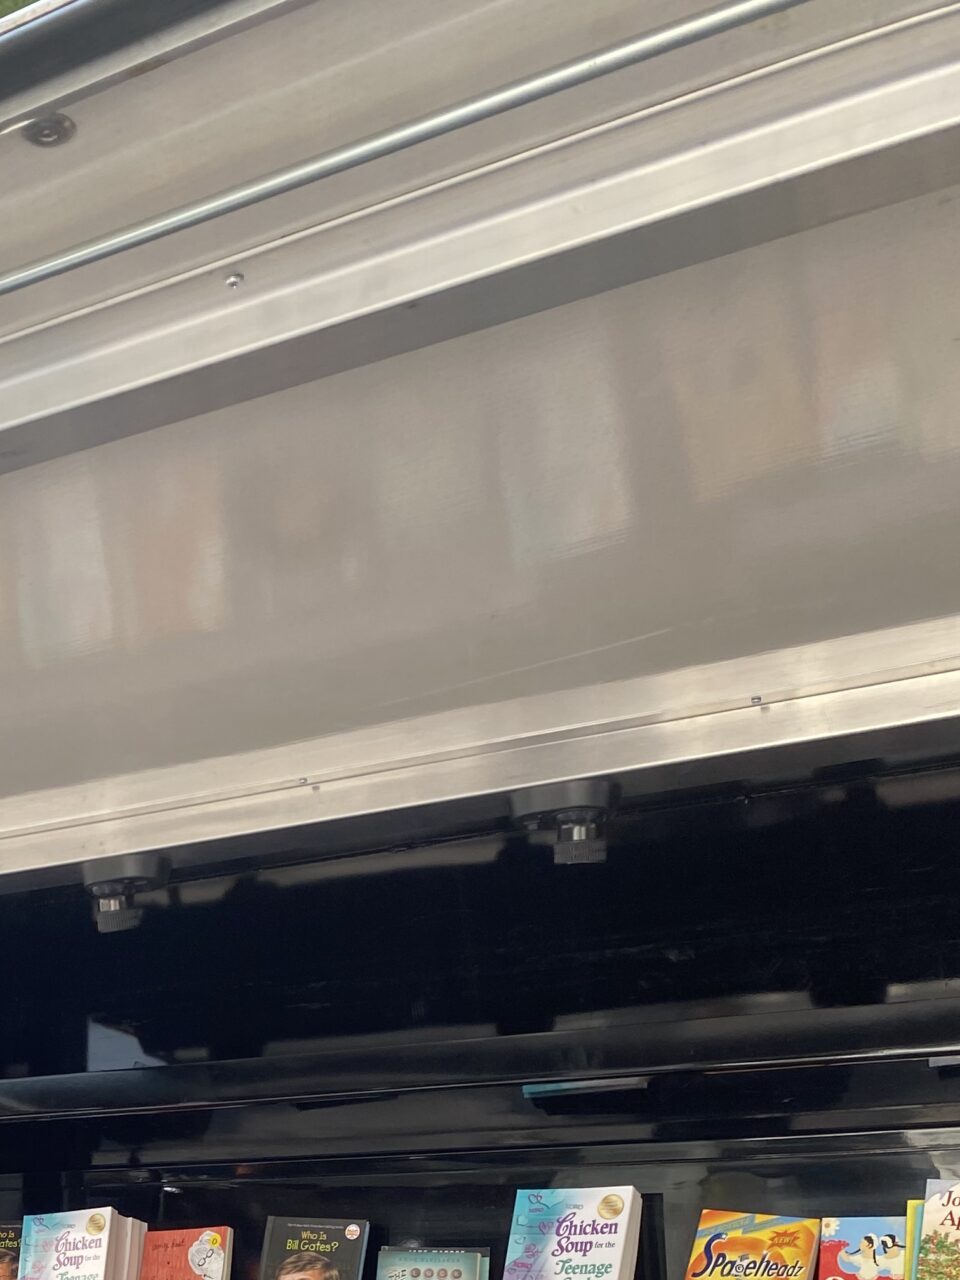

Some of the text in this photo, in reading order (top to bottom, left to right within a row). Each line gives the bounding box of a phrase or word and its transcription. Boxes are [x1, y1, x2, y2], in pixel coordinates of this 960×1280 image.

[556, 1212, 618, 1237] Chicken
[55, 1231, 102, 1254] Chicken
[301, 1231, 327, 1240] Who Is
[286, 1240, 339, 1252] Bill Gates?
[552, 1236, 593, 1256] Soup
[52, 1254, 84, 1271] Soup
[554, 1259, 612, 1278] Teenage
